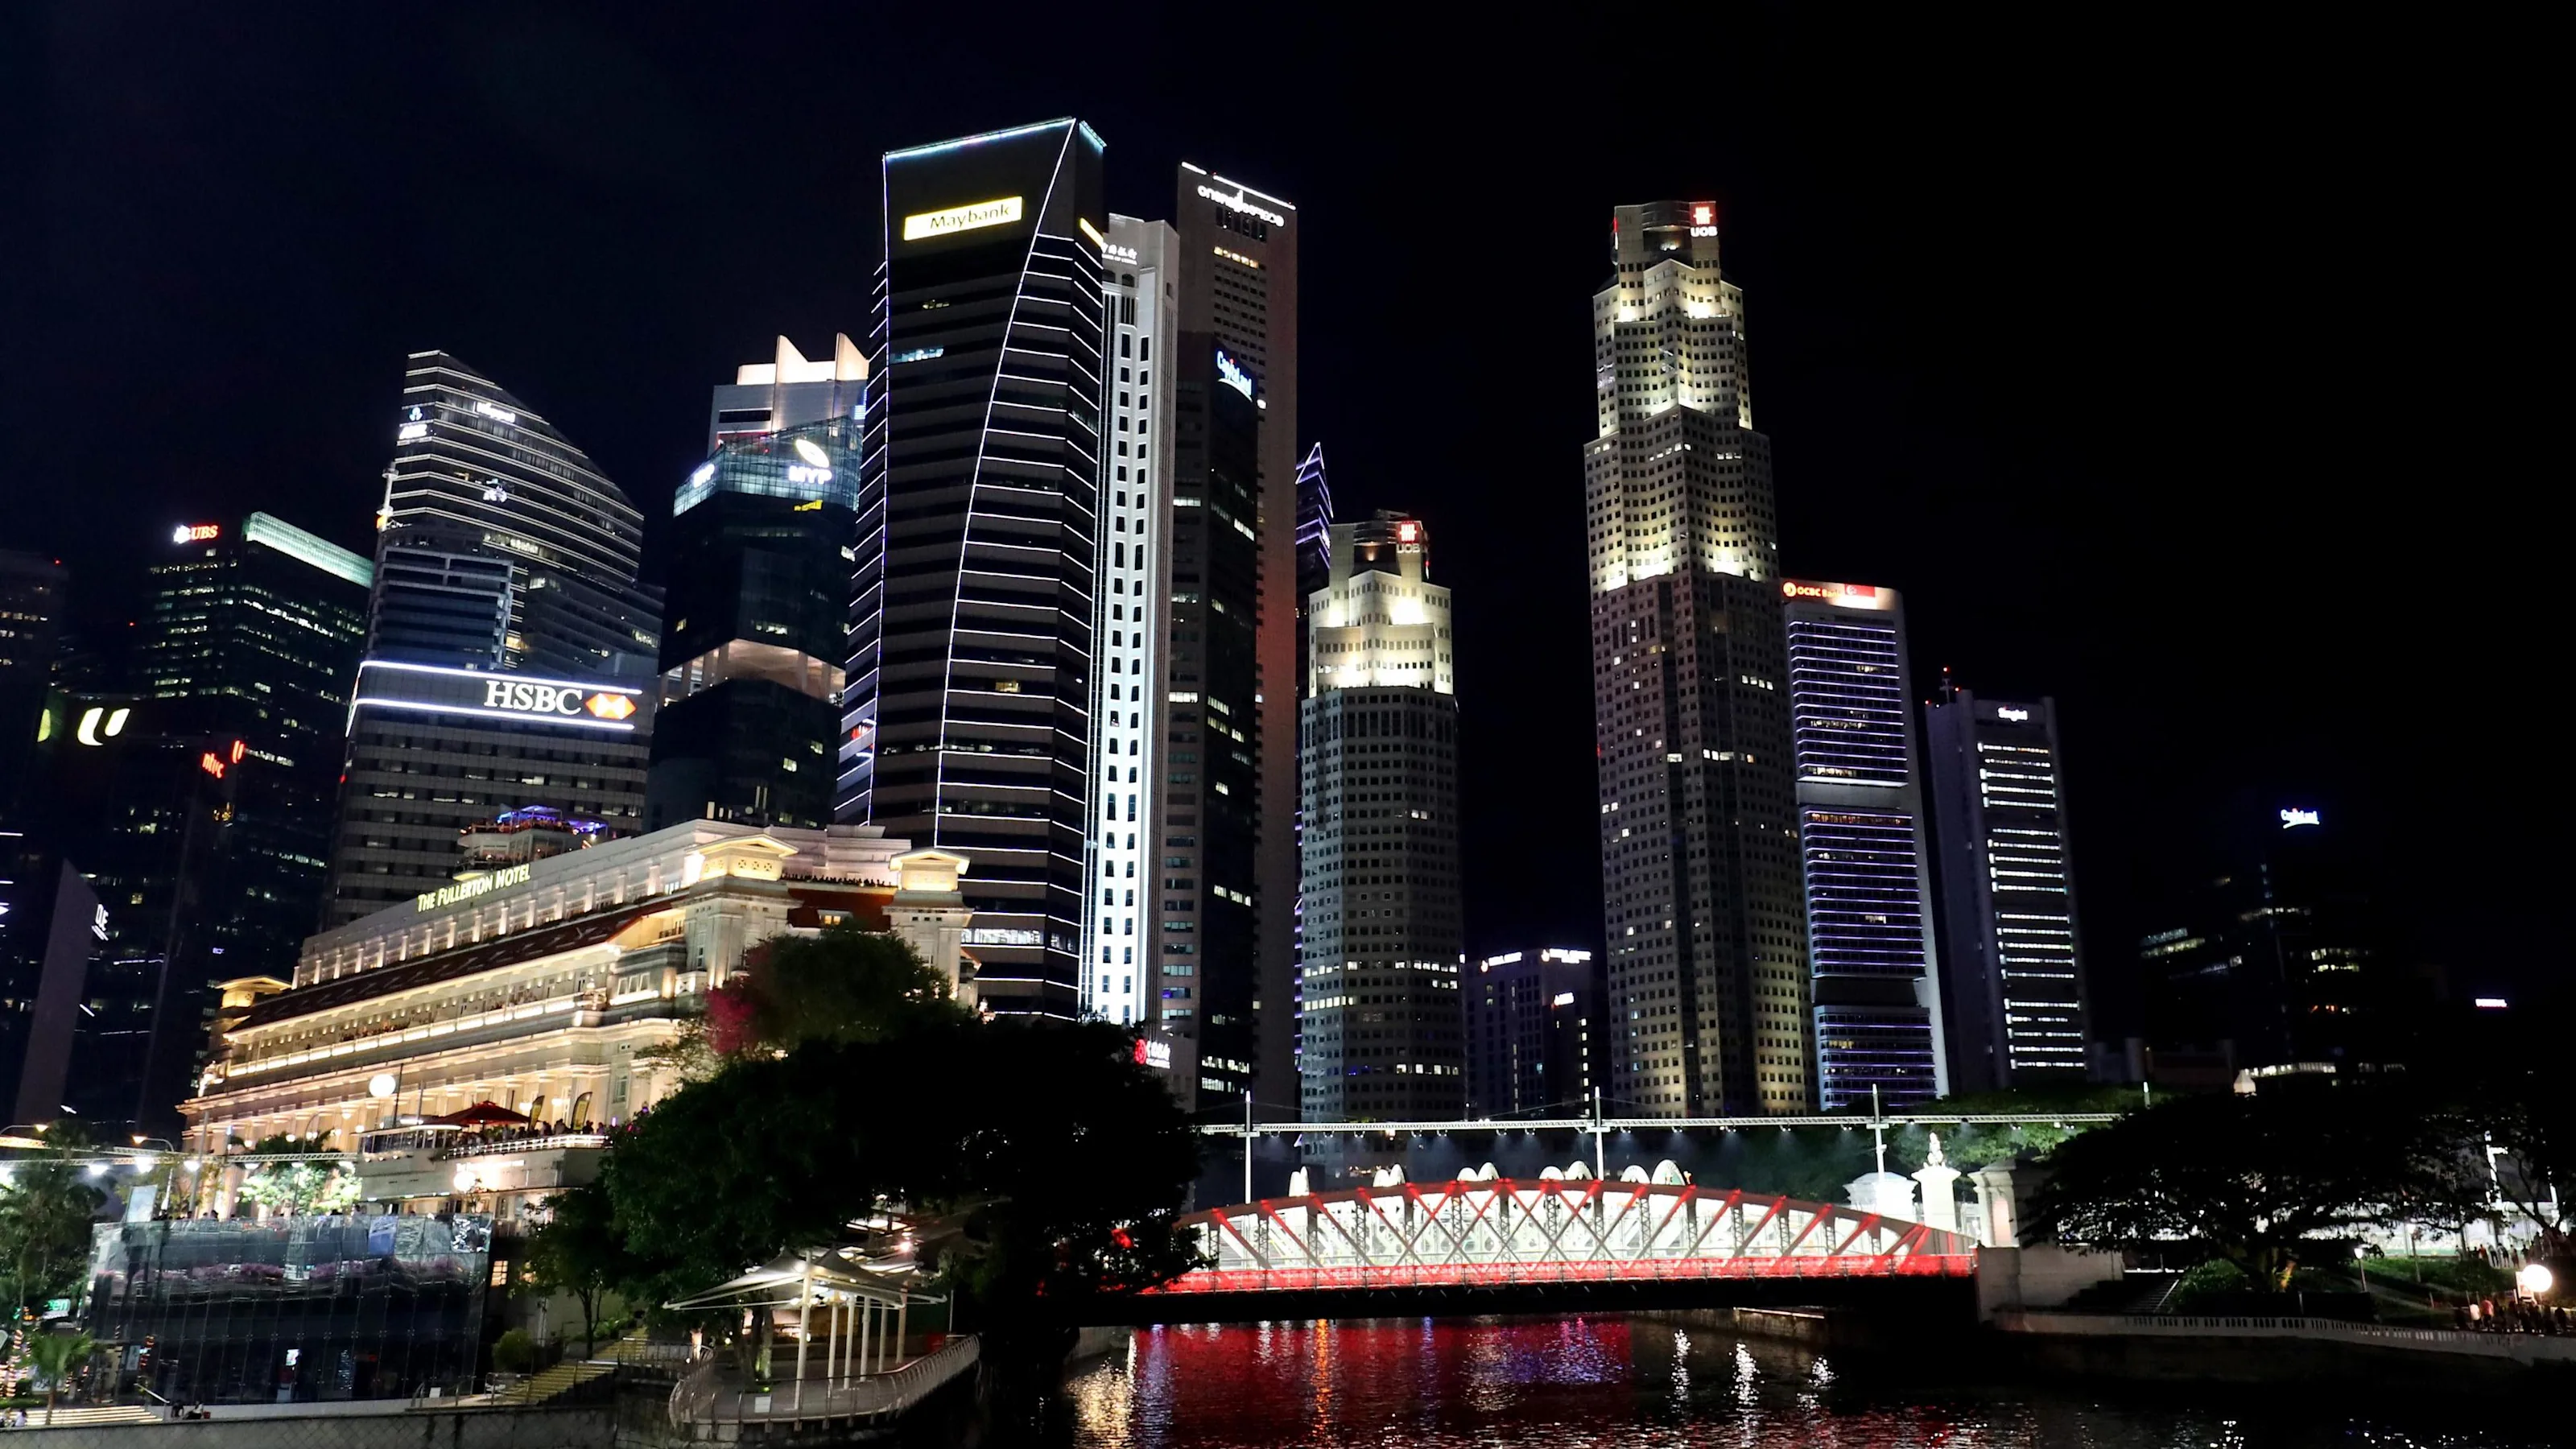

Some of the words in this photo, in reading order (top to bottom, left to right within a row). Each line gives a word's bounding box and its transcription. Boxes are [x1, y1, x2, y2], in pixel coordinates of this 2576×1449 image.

[931, 204, 1009, 229] Maybank
[1690, 226, 1718, 237] UOB
[191, 525, 218, 540] UBS
[1396, 543, 1421, 554] UOB
[1797, 587, 1821, 597] OCBC
[484, 680, 583, 716] HSBC
[417, 893, 437, 913] THE
[437, 875, 493, 907] FULLERTON
[494, 864, 531, 890] HOTEL
